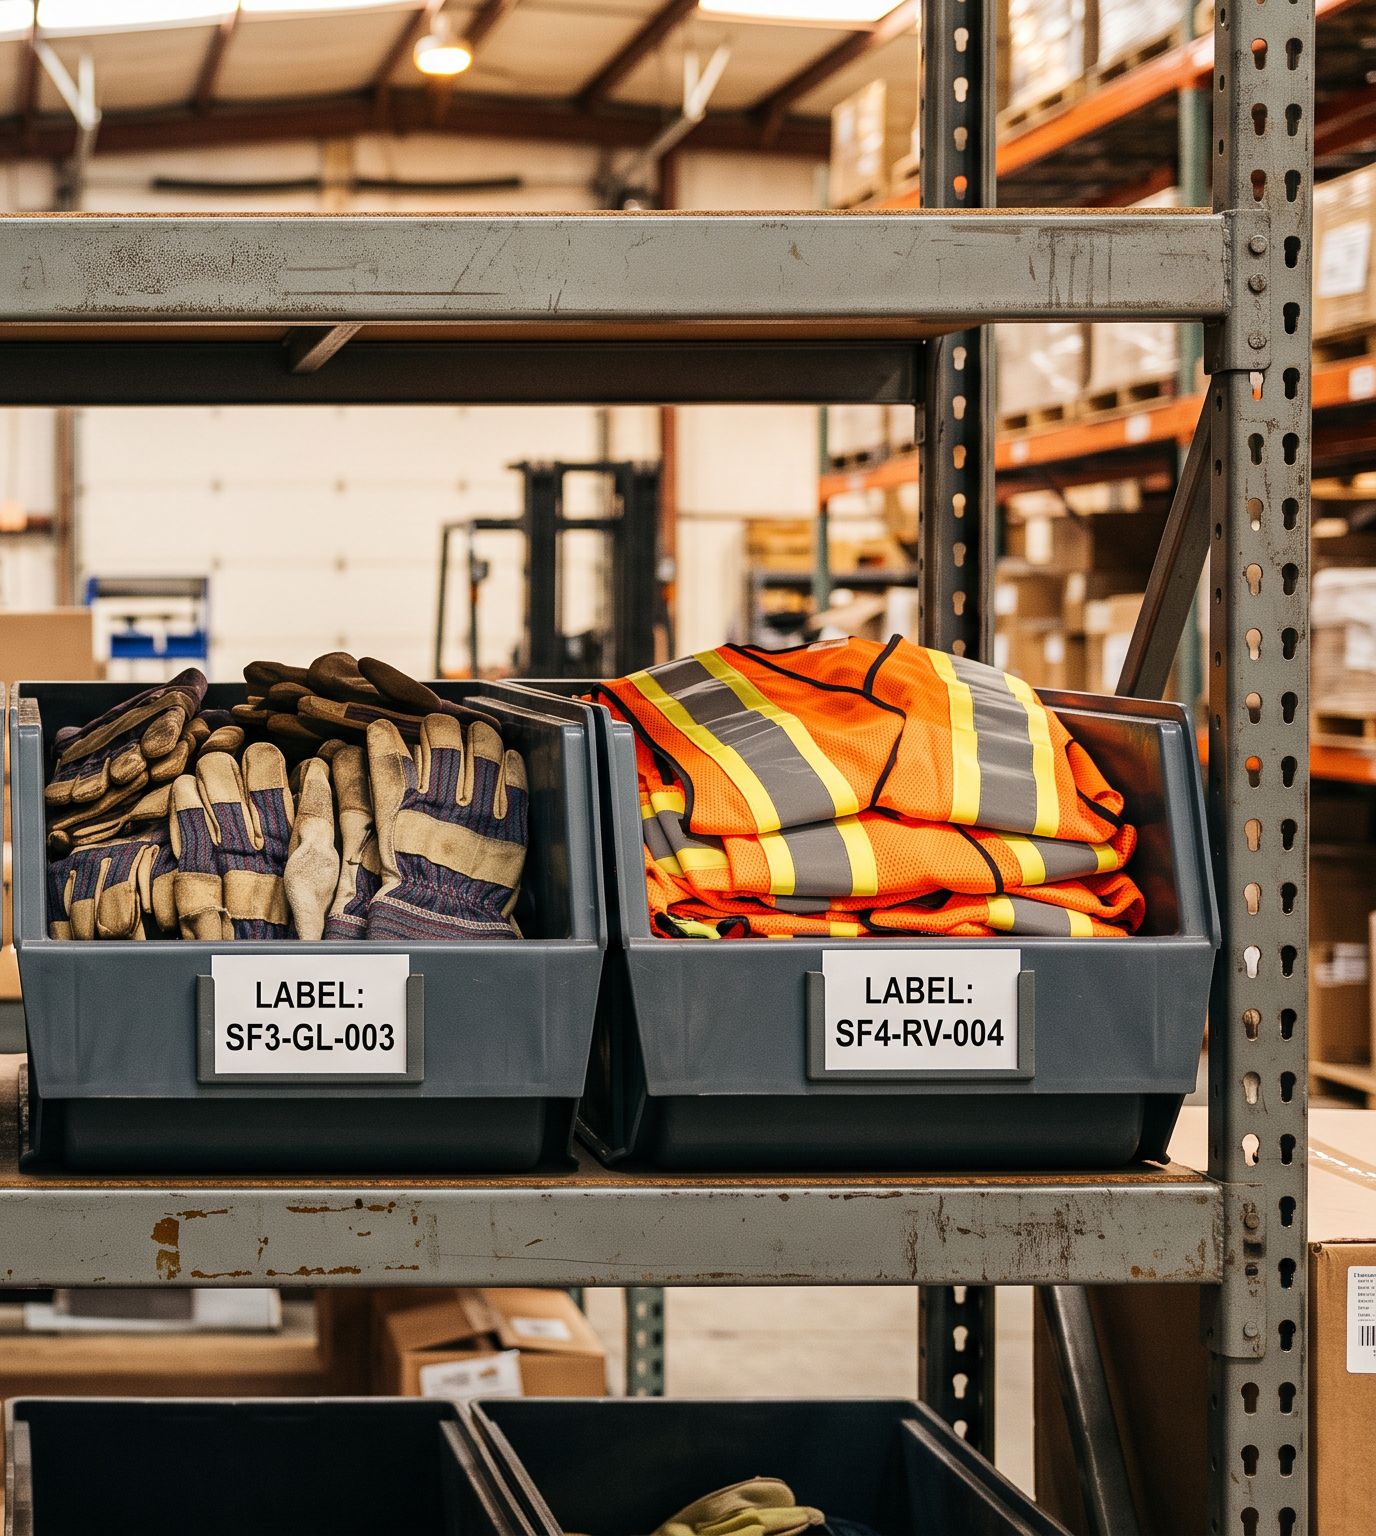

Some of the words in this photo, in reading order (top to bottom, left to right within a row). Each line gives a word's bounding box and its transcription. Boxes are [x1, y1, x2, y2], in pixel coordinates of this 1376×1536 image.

[256, 981, 363, 1009] LABEL:
[865, 976, 973, 1004] LABEL:
[225, 1023, 395, 1052] SF3-GL-003
[835, 1018, 1005, 1048] SF4-RV-004
